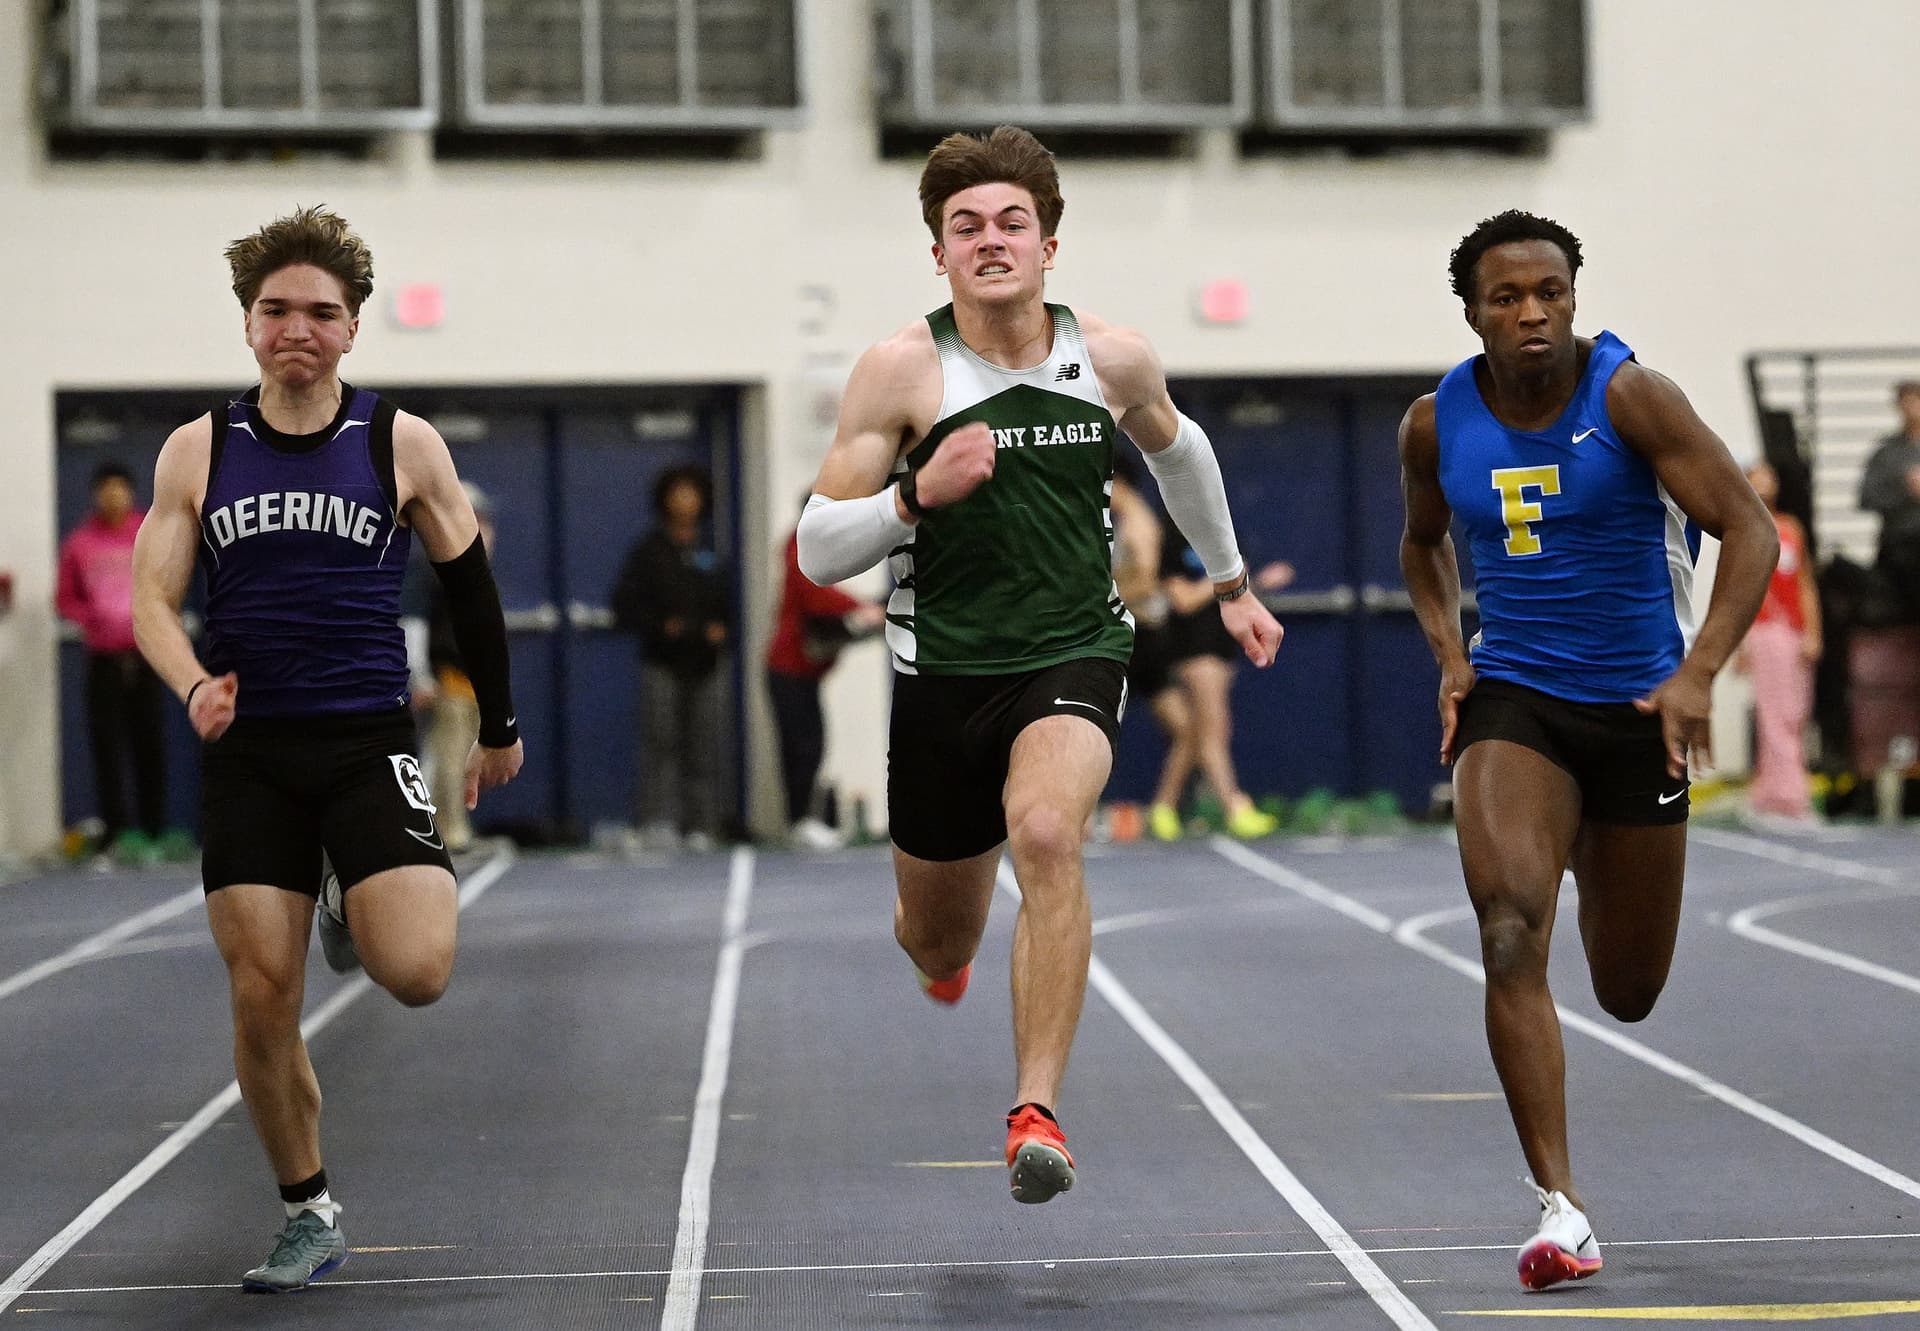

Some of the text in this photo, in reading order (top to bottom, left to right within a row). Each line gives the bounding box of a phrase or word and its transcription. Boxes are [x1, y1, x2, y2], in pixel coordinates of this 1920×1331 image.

[1033, 422, 1102, 446] EAGLE
[209, 491, 382, 549] DEERING
[1491, 464, 1561, 557] F
